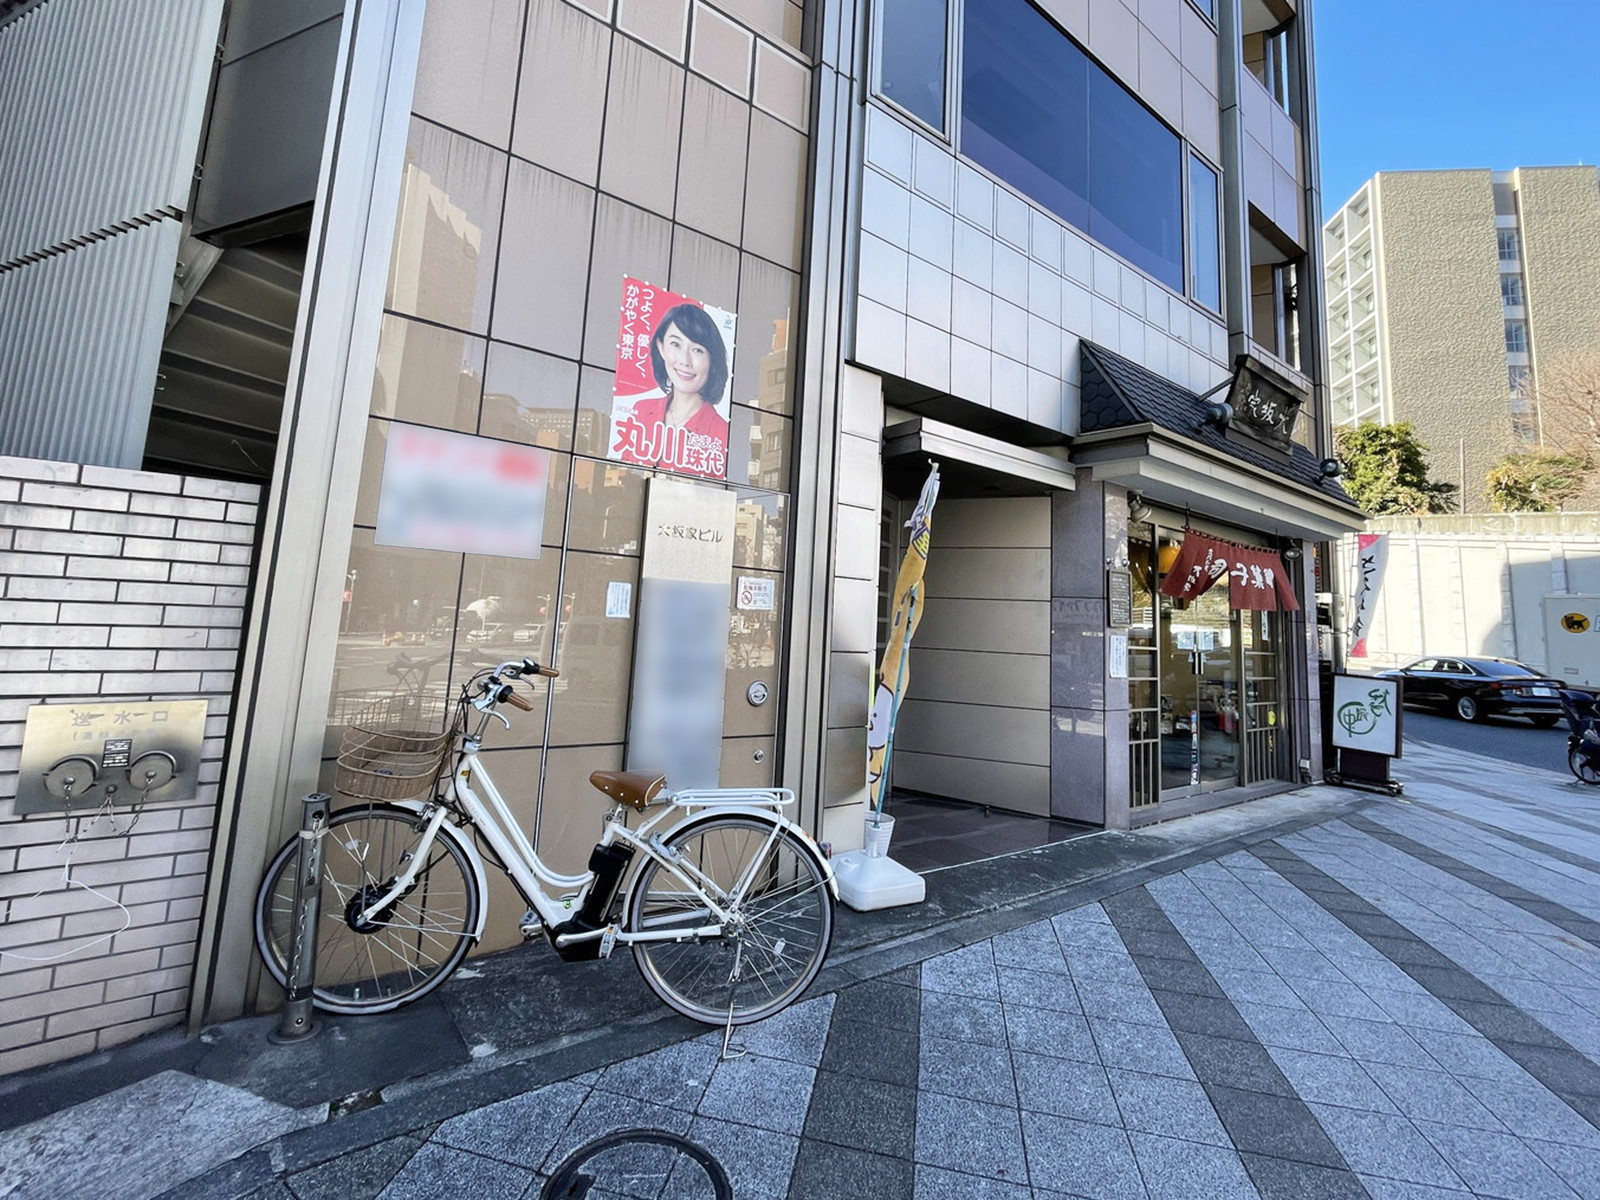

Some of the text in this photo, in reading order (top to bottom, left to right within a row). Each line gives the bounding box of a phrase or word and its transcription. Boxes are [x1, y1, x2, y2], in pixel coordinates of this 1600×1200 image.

[620, 284, 640, 361] かがやく東京
[635, 288, 655, 378] つよく、優しく、
